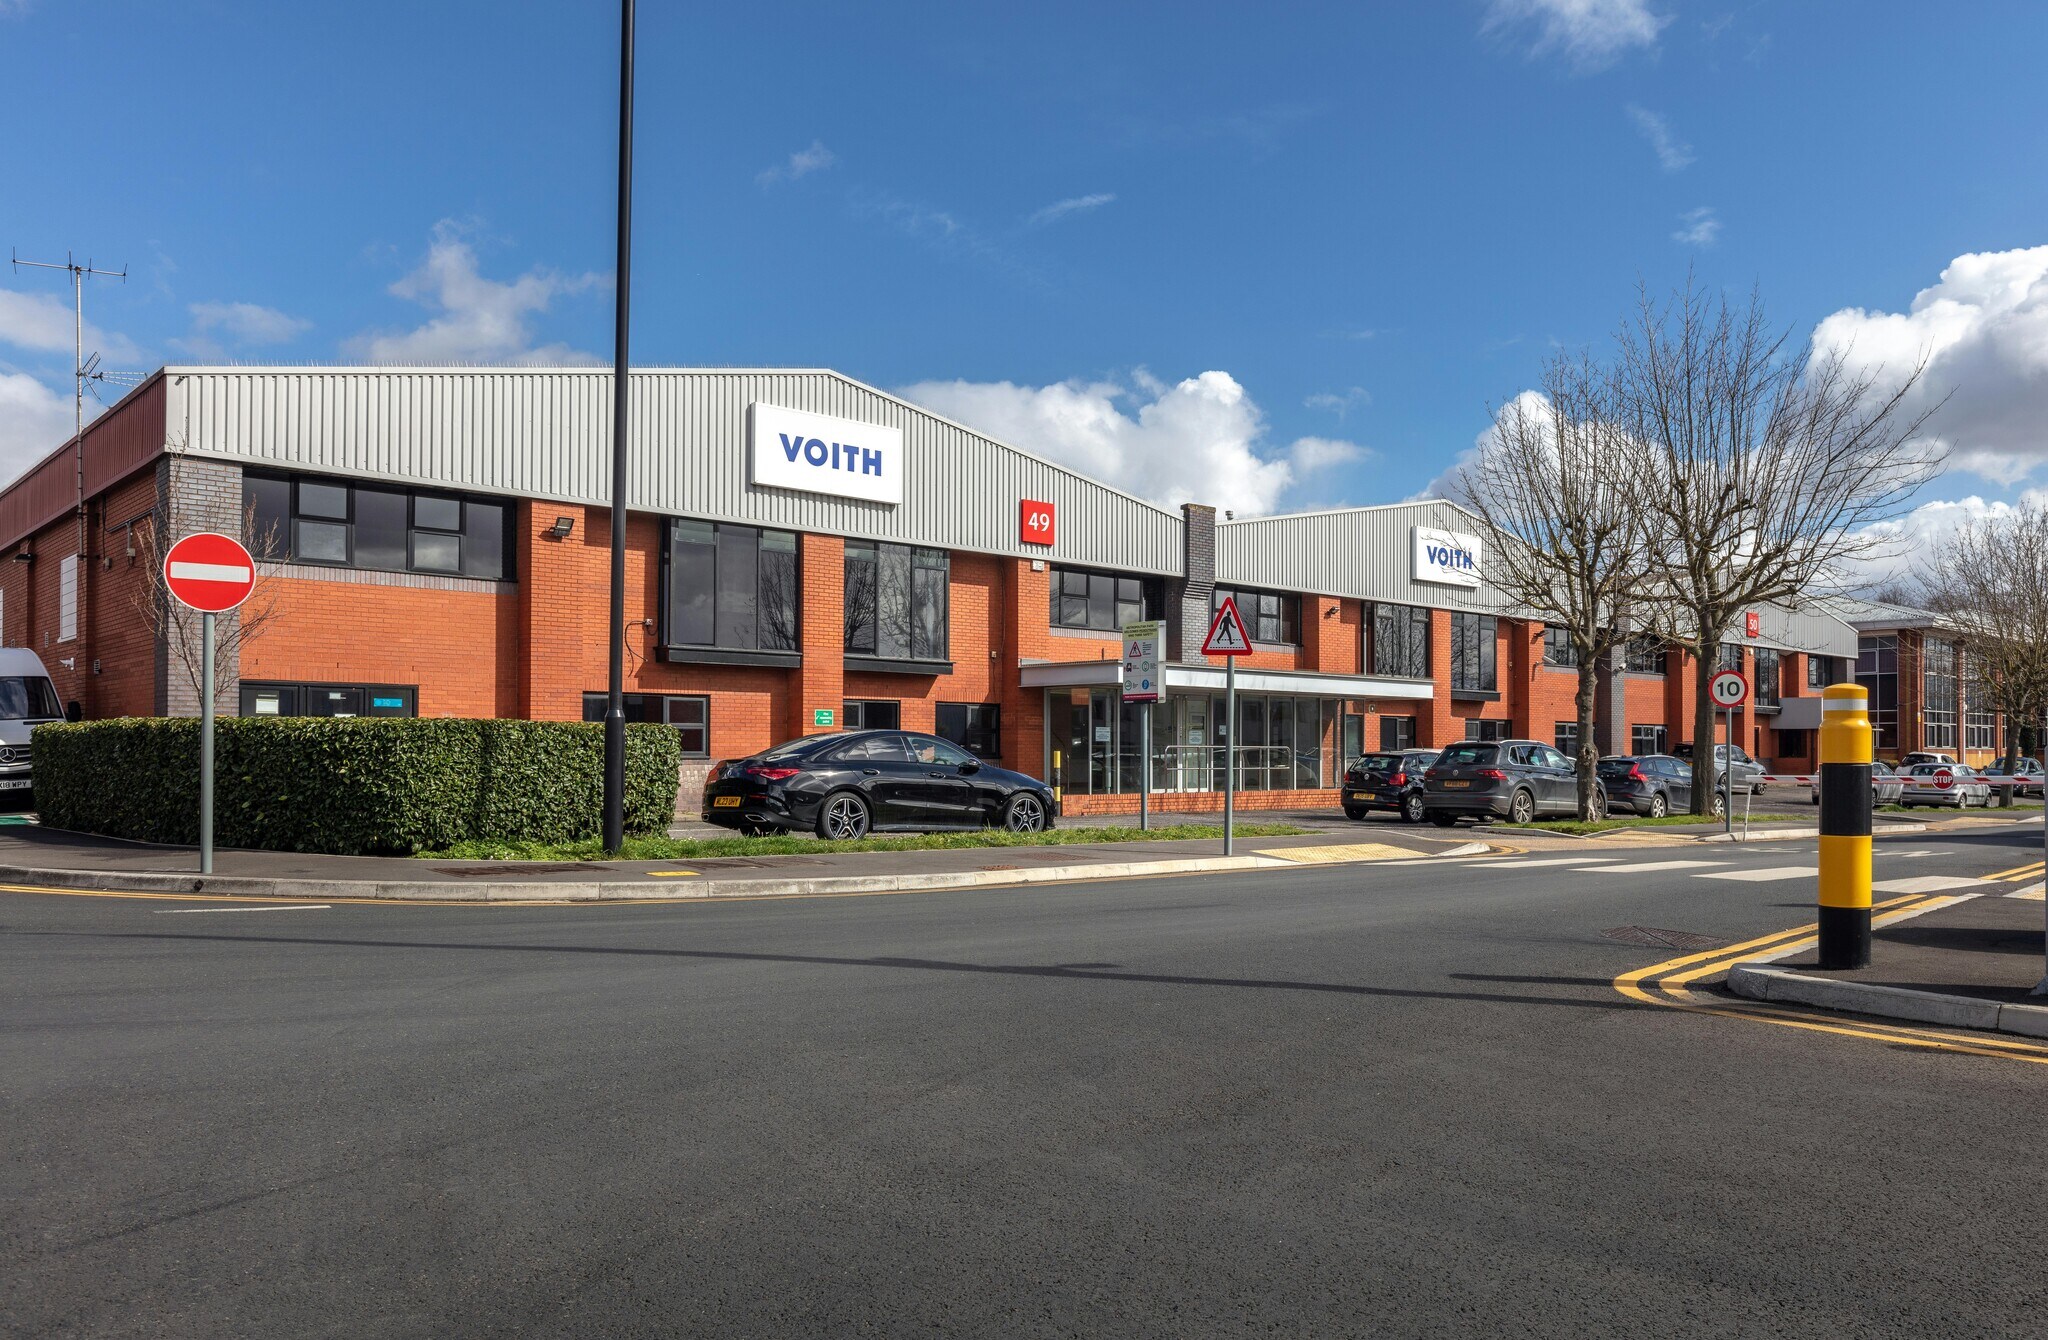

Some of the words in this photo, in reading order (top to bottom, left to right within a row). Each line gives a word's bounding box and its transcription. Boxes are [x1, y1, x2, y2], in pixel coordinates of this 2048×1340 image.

[779, 433, 882, 476] VOITH
[1028, 512, 1050, 532] 49
[1426, 545, 1472, 569] VOITH
[1749, 619, 1758, 630] 50
[1717, 681, 1740, 697] 10
[1933, 775, 1953, 784] STOP
